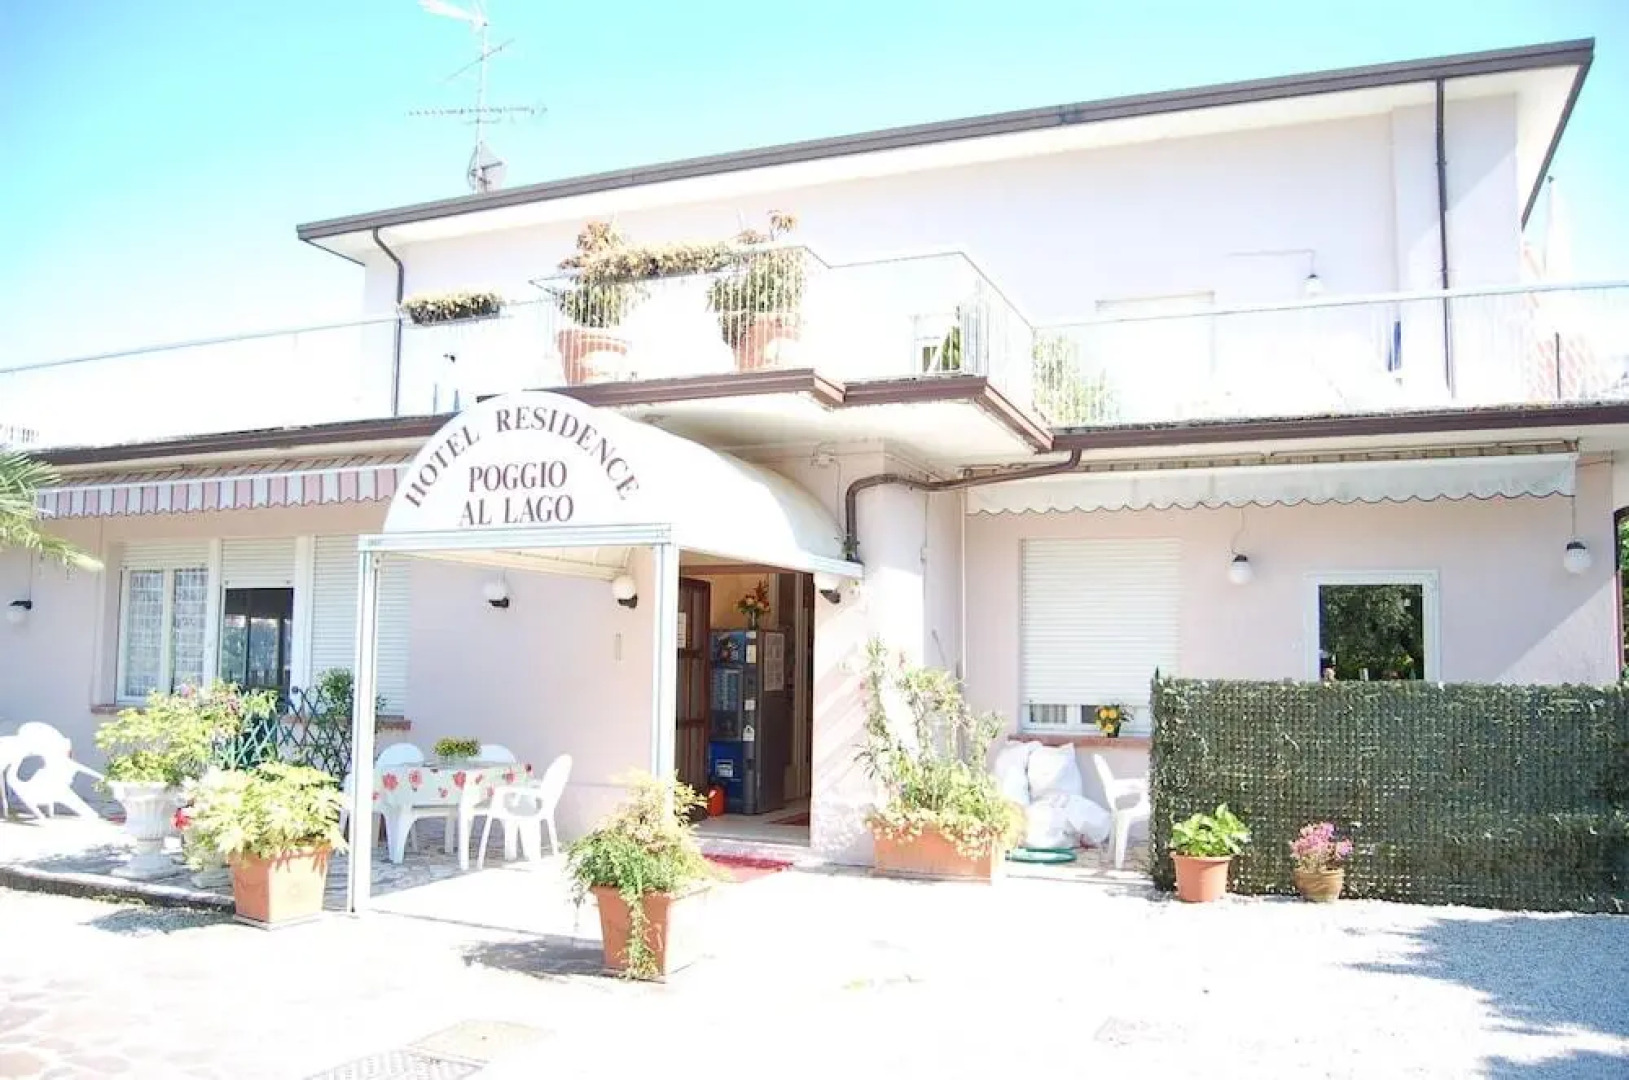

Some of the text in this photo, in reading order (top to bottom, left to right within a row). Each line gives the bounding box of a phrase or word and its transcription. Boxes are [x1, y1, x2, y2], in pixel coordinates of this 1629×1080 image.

[405, 406, 639, 507] HOTEL RESIDENCE
[468, 460, 567, 492] POGGIO
[459, 495, 574, 526] AL LAGO
